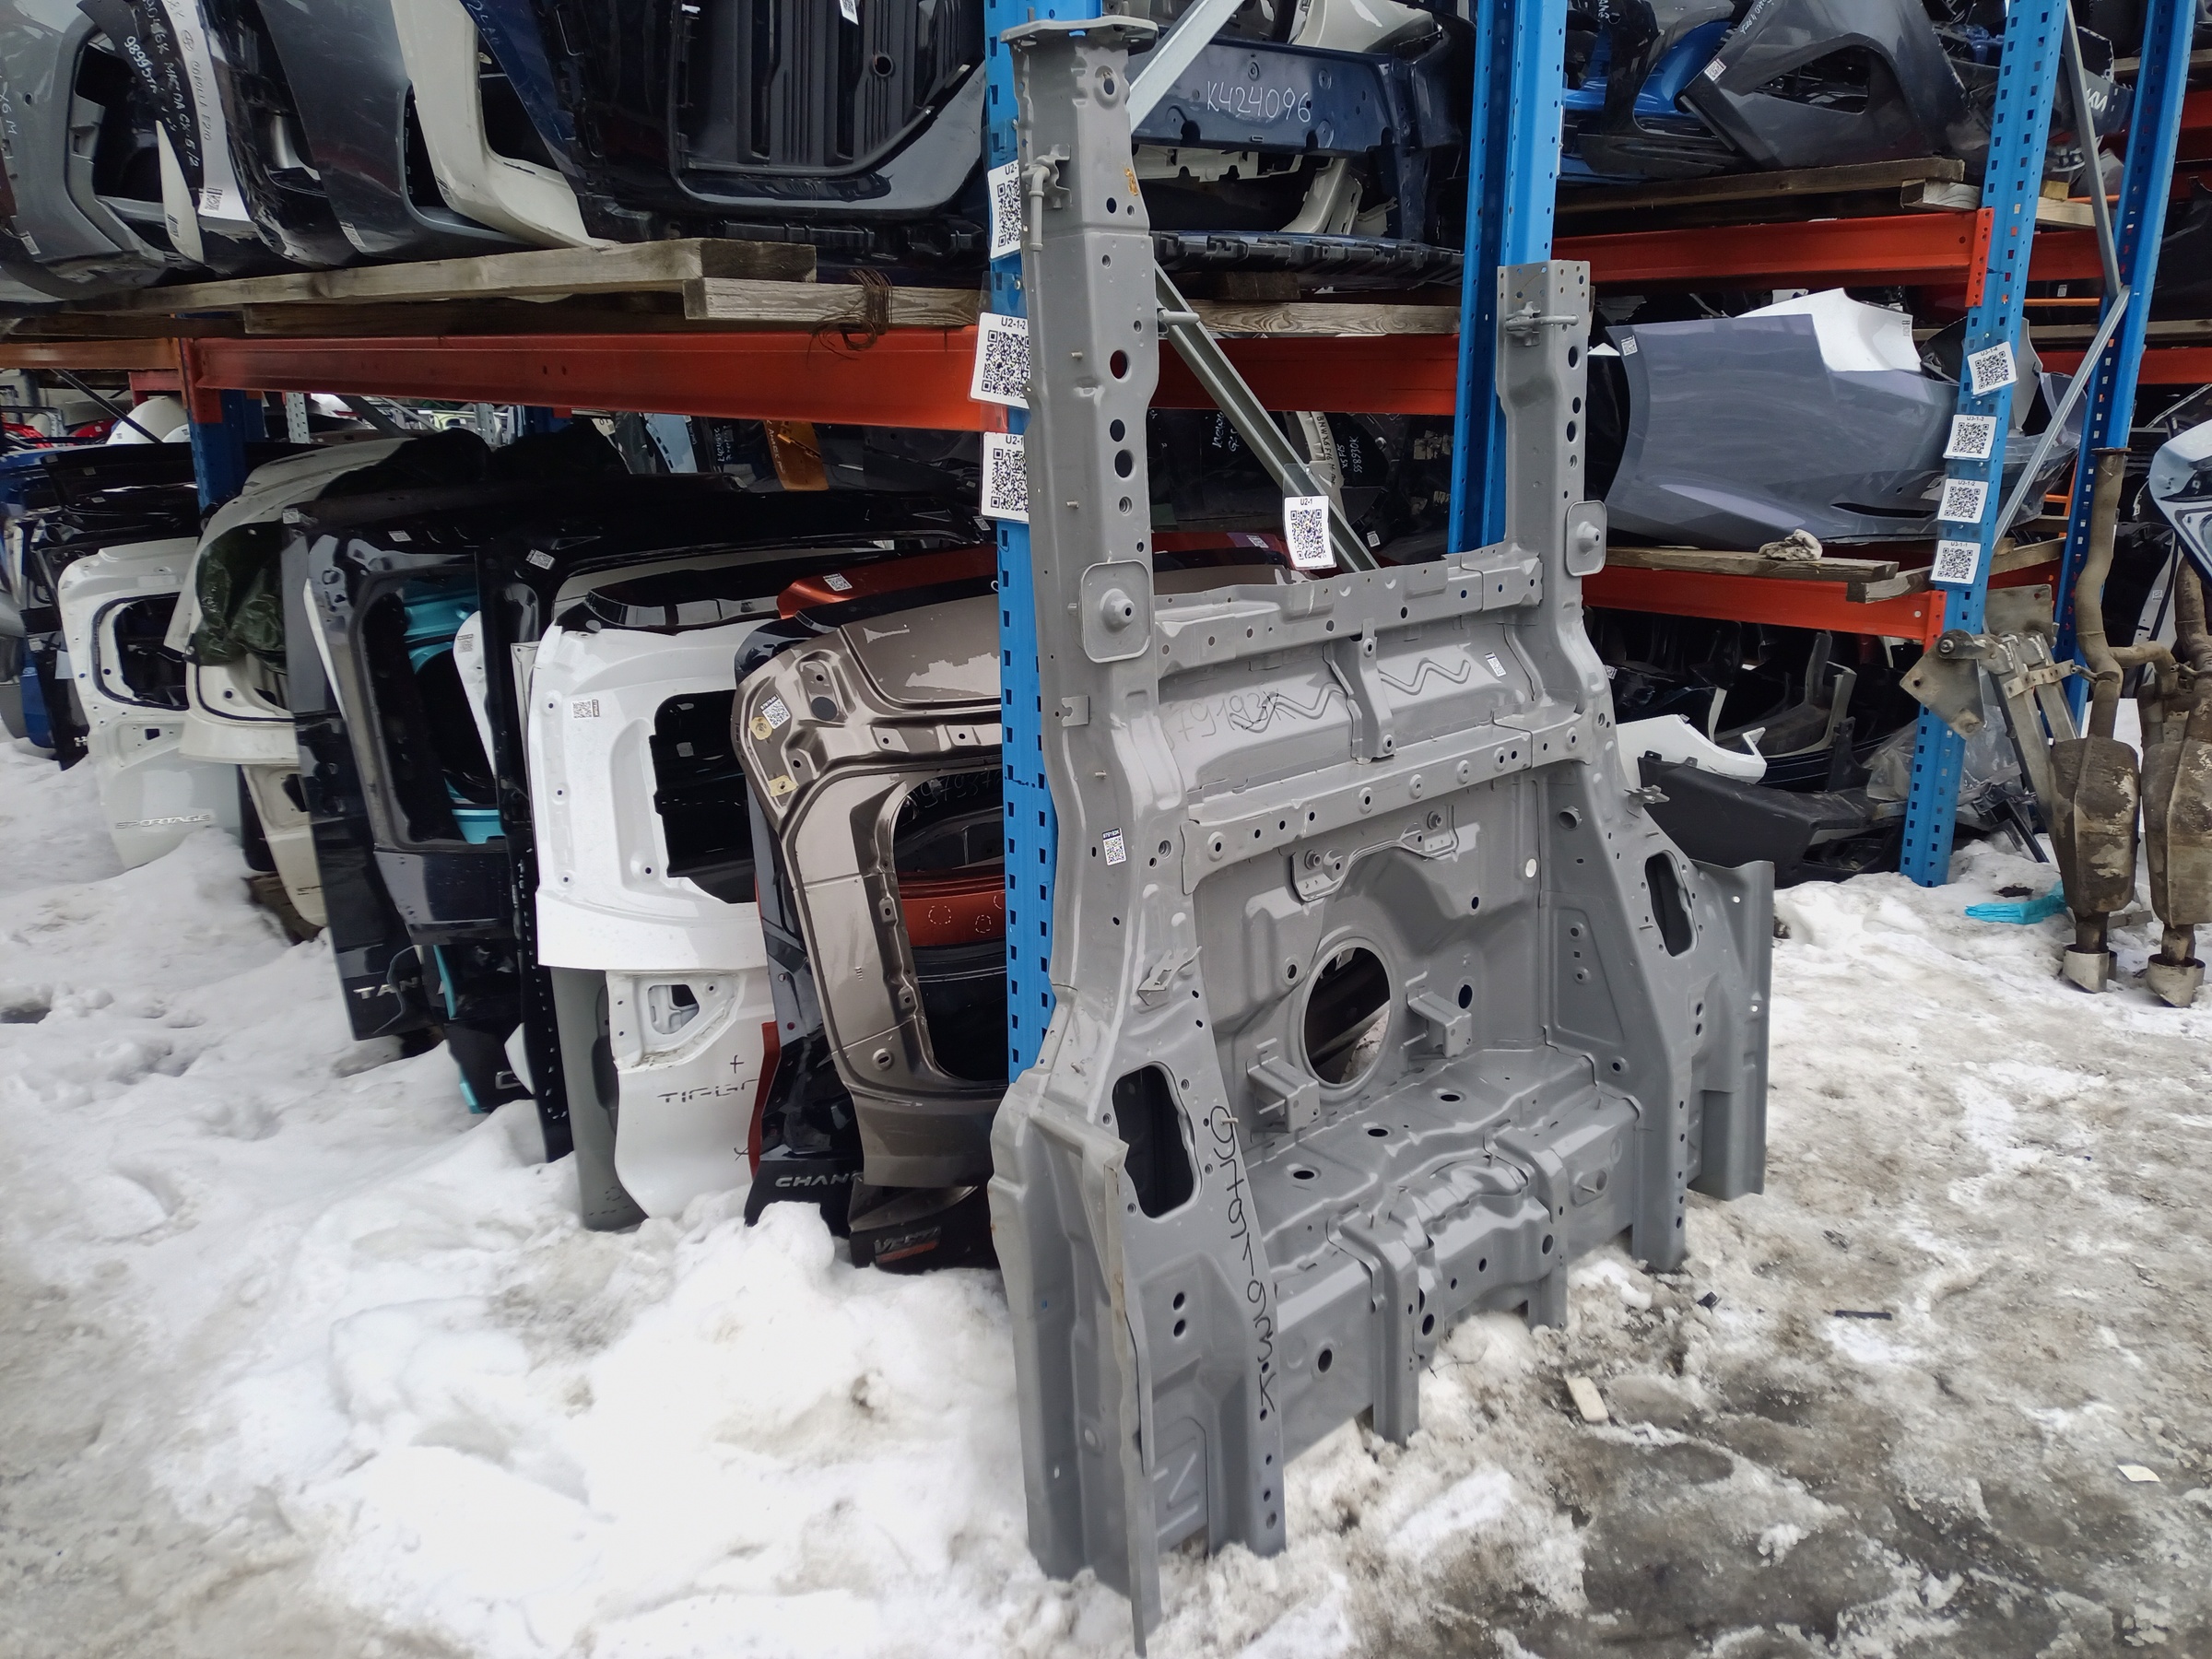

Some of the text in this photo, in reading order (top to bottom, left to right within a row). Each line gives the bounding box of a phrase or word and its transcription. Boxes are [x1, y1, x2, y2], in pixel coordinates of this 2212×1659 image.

[1207, 80, 1312, 123] K424096
[1005, 163, 1018, 175] U2-
[1001, 317, 1026, 330] U2-1-2
[1300, 498, 1313, 506] U2-1
[115, 814, 211, 830] SPORTAGE
[1210, 1105, 1277, 1413] 979193K
